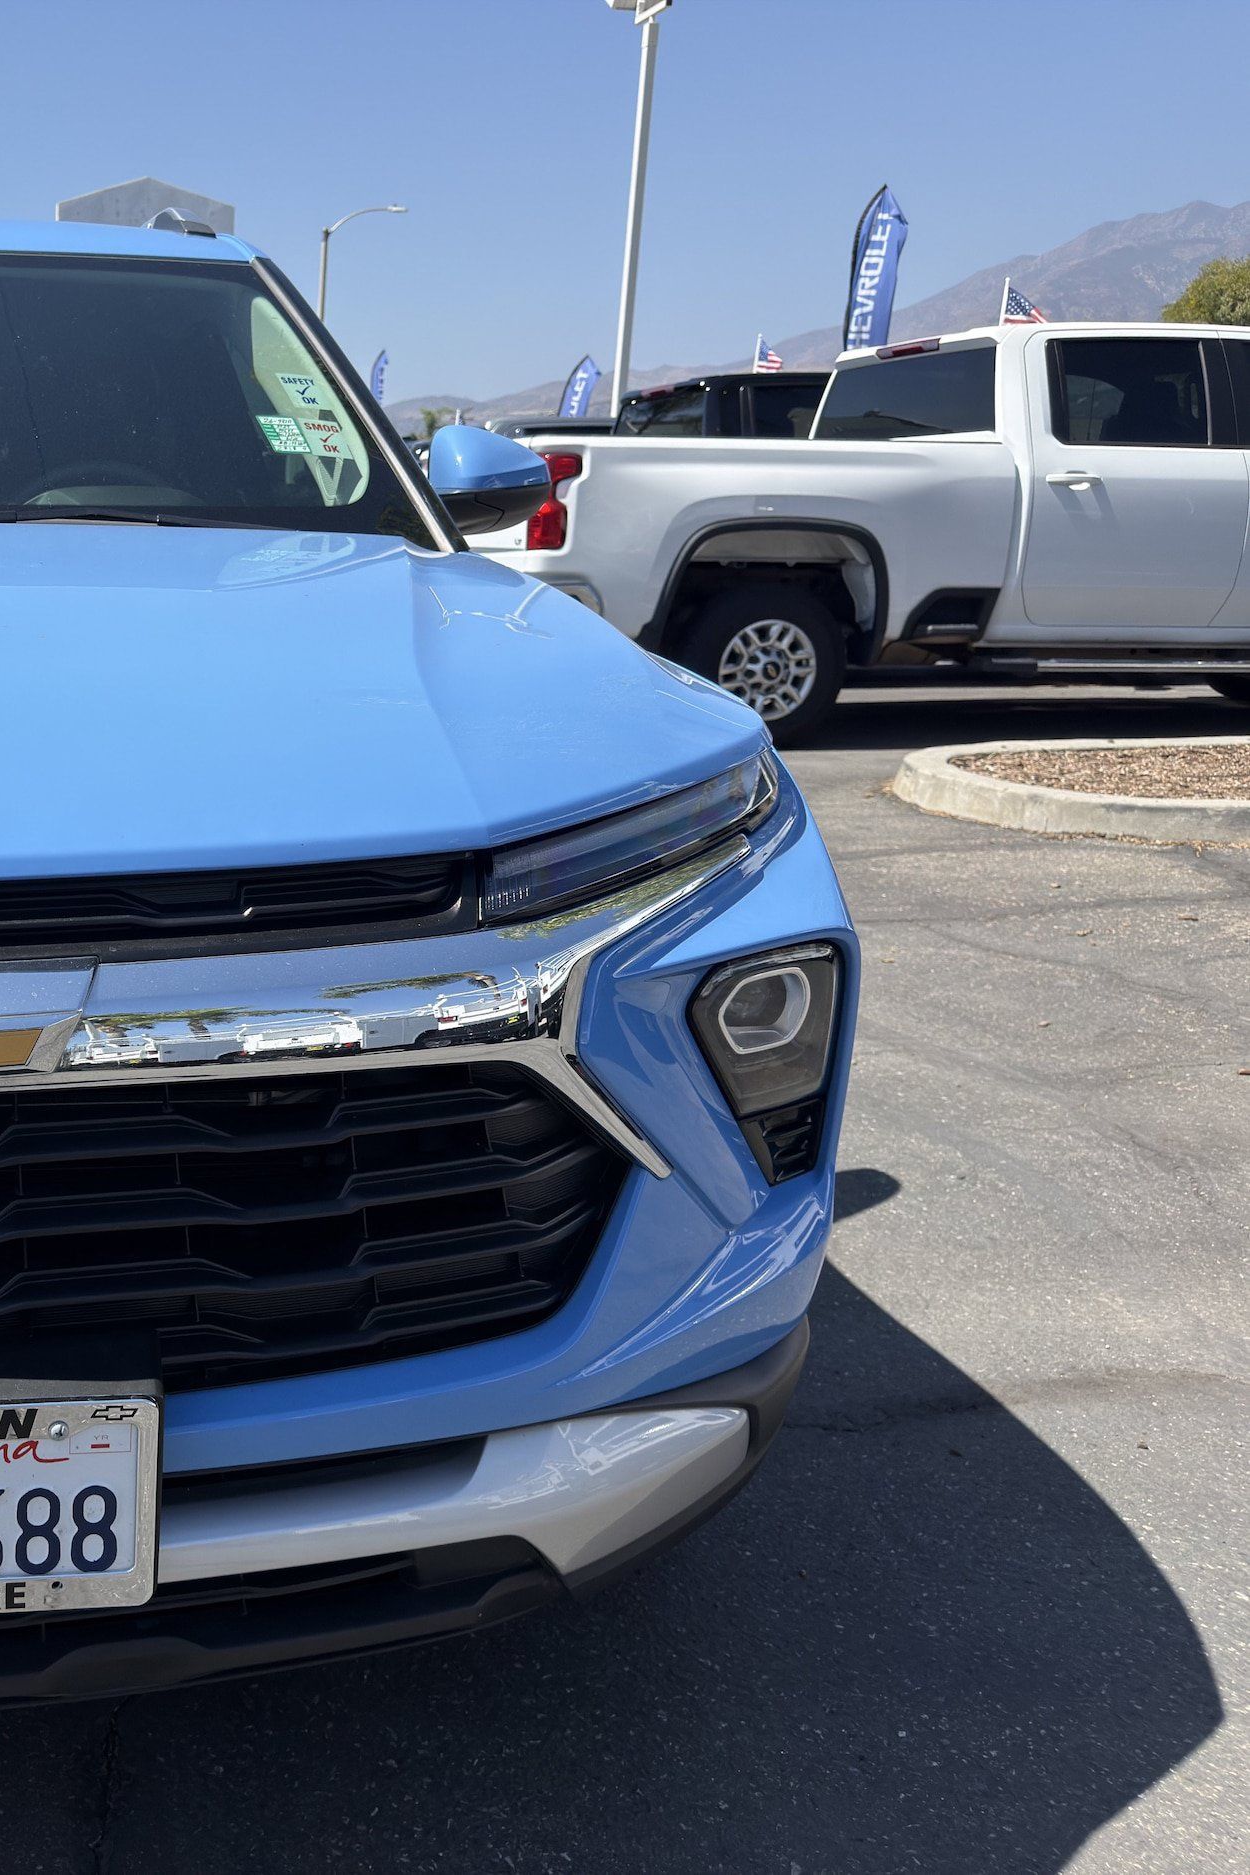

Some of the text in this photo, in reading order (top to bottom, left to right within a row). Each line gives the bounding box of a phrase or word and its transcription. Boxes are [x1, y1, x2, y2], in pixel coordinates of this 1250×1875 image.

[847, 212, 895, 350] HEVROLE
[280, 376, 315, 387] SAFETY
[302, 396, 320, 405] OK
[304, 422, 340, 433] SMOG
[323, 444, 341, 453] OK
